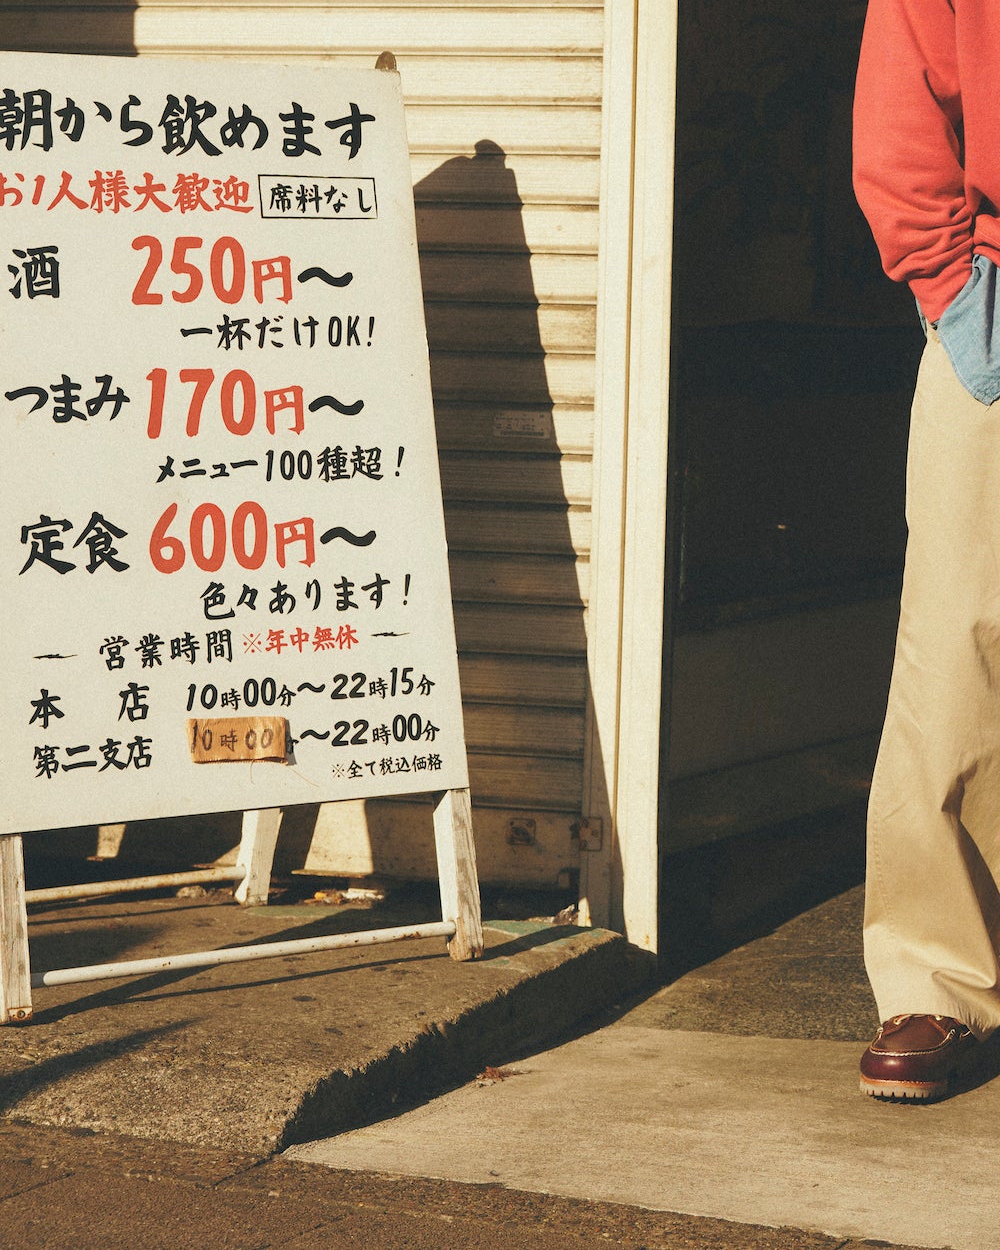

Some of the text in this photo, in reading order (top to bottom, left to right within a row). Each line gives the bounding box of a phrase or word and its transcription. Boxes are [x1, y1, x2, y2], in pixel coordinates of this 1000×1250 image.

[0, 88, 376, 160] 朝から飲めます
[269, 183, 373, 214] 席料なし
[8, 246, 60, 299] 酒
[4, 374, 131, 423] つまみ
[19, 511, 131, 575] 定食
[99, 628, 234, 671] 営業時間
[33, 735, 154, 780] 第二支店
